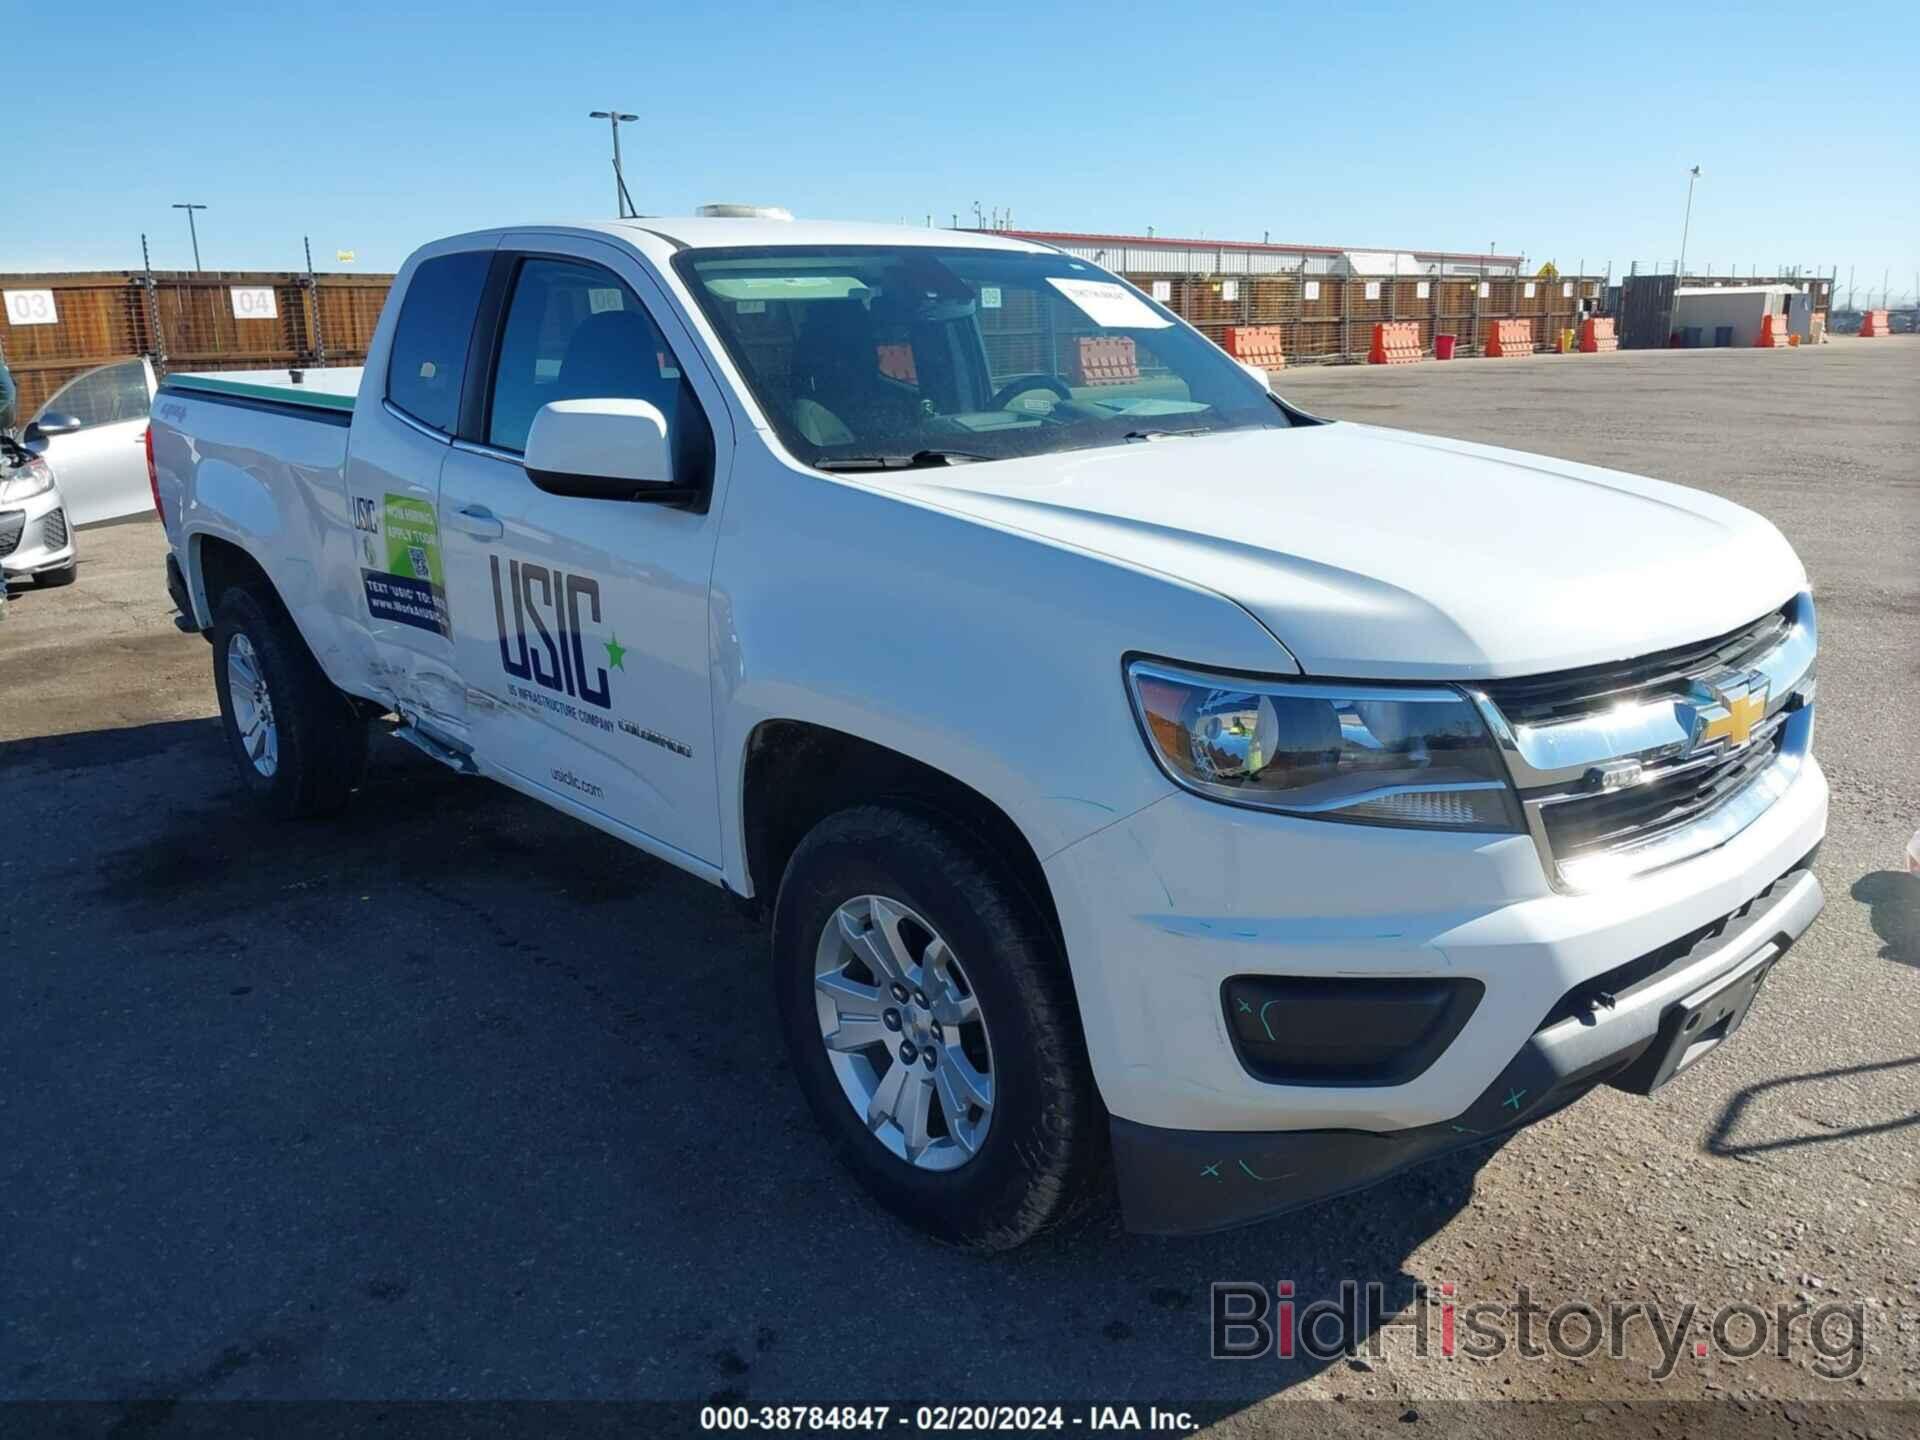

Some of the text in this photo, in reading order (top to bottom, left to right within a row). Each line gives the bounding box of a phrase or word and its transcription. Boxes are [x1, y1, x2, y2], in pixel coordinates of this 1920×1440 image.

[15, 293, 49, 319] 03
[239, 290, 270, 314] 04
[352, 496, 377, 534] USIC
[366, 580, 389, 594] TEXT
[490, 554, 611, 710] USIC
[507, 683, 614, 733] US INFRASTRUCTURE COMPANY
[551, 767, 604, 799] usicllc.com
